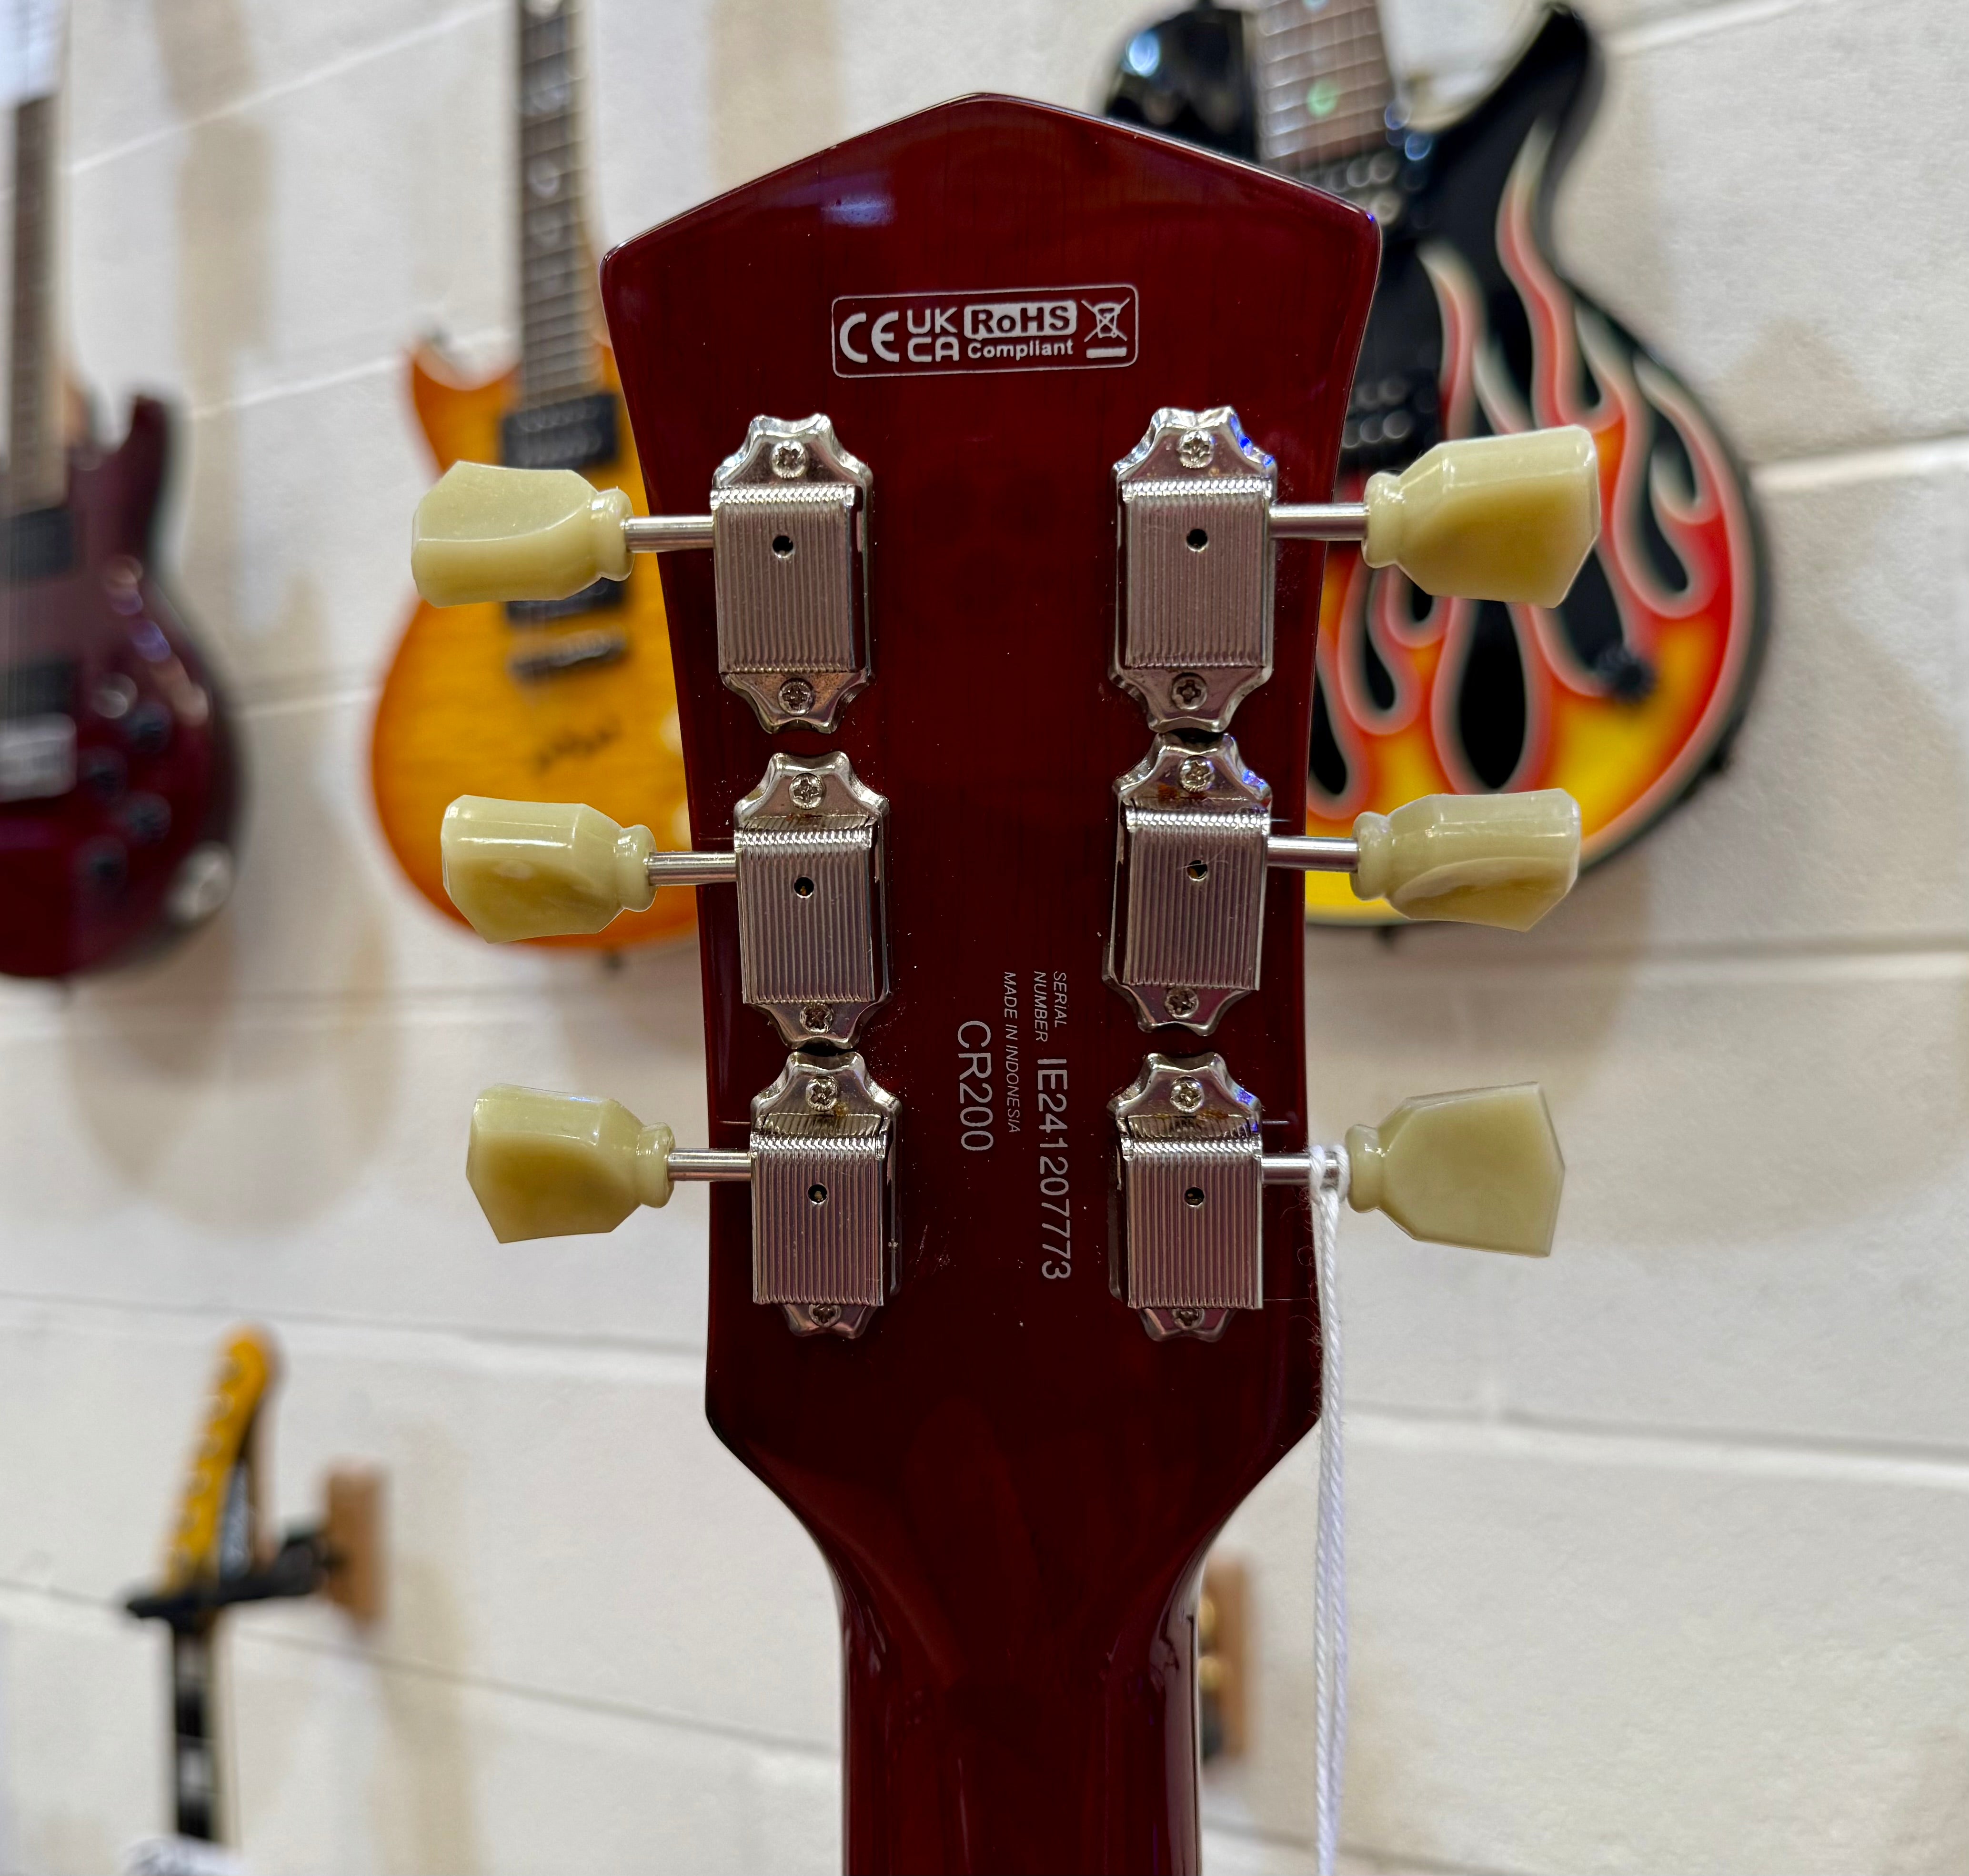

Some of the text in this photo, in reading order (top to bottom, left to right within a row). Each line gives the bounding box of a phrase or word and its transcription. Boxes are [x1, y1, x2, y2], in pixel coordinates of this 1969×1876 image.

[840, 312, 900, 363] CE
[907, 307, 958, 334] UK
[971, 305, 1070, 337] RoHS
[907, 336, 959, 362] CA
[967, 339, 1074, 361] Compliant
[1054, 971, 1067, 1028] SERIAL
[1004, 972, 1021, 1133] MADE IN INDONESIA
[957, 1020, 994, 1151] CR200
[1034, 971, 1071, 1279] NUMBER IE2412077773
